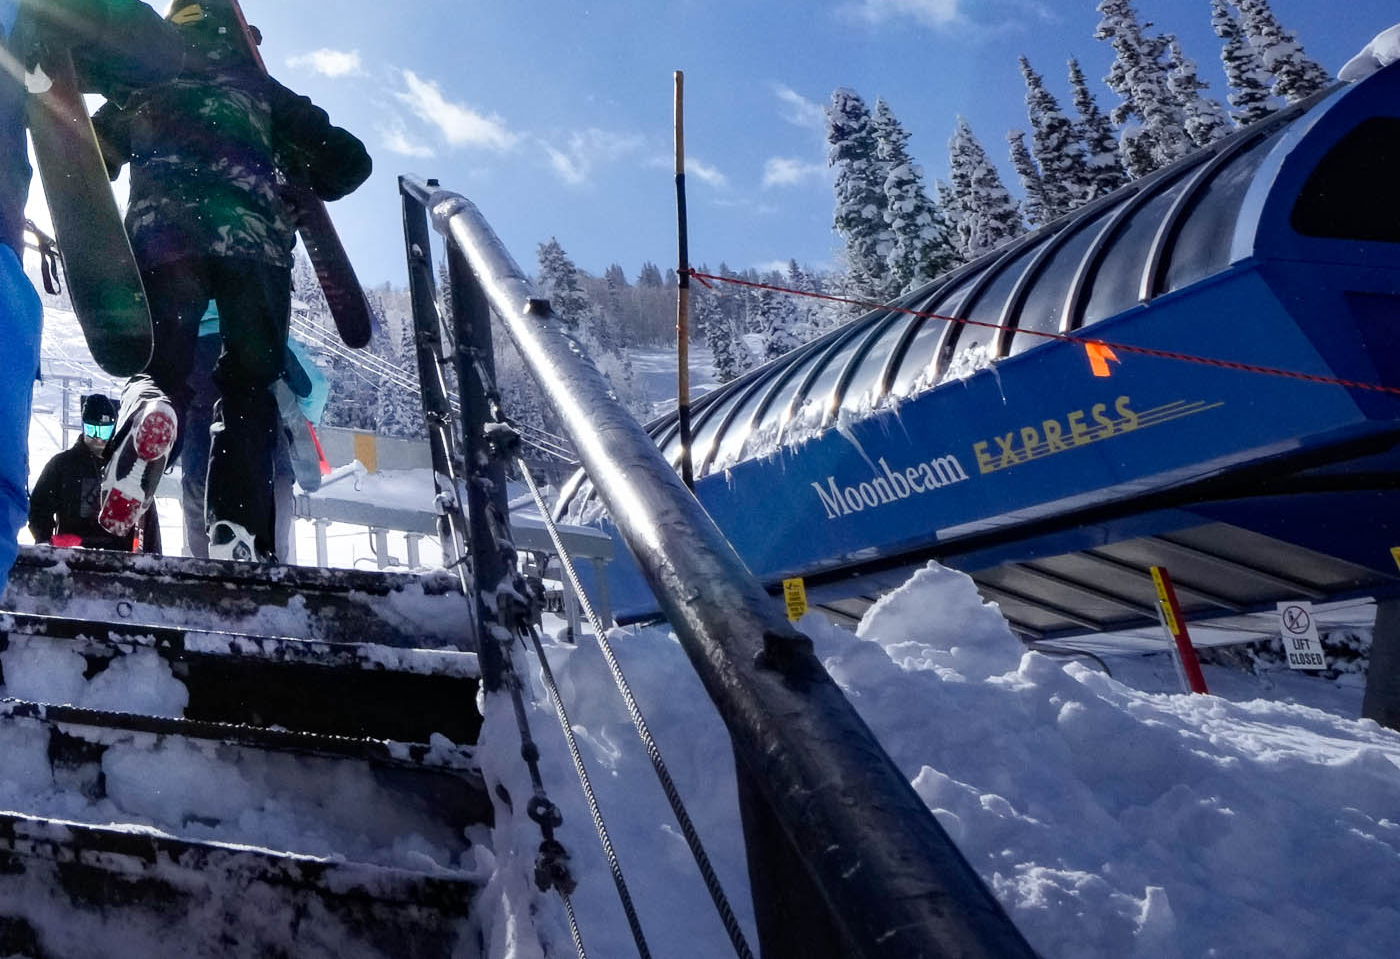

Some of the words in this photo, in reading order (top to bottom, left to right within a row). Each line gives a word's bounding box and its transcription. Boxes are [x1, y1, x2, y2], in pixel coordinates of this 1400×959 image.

[811, 452, 970, 520] Moonbeam
[973, 395, 1141, 475] EXPRESS
[1293, 638, 1310, 650] LIFT
[1289, 653, 1323, 666] CLOSED
